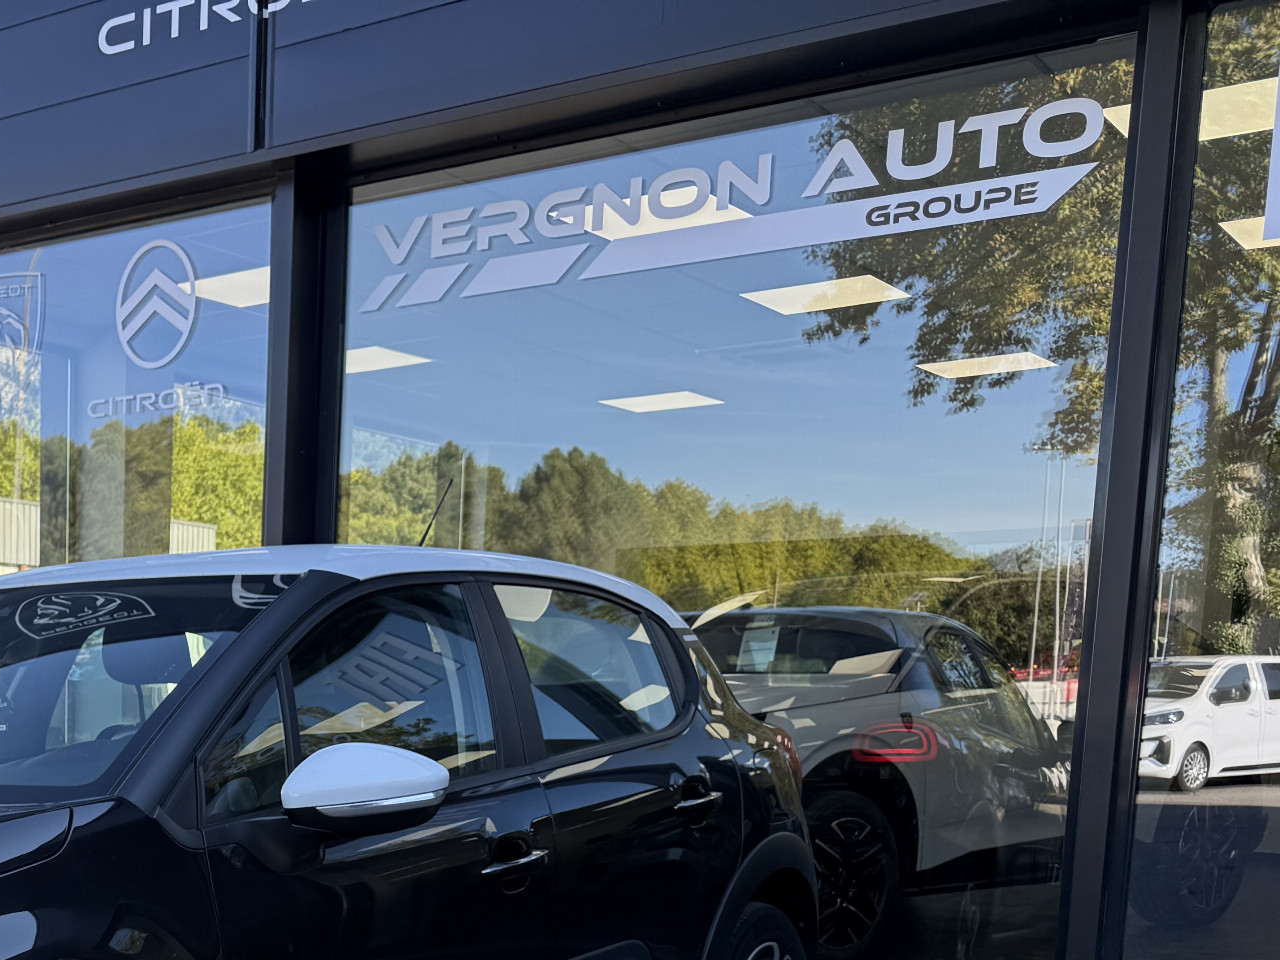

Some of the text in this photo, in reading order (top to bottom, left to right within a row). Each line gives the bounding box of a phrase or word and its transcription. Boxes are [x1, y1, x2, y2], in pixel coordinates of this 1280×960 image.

[98, 0, 312, 55] CITR
[373, 98, 1104, 265] VERGNON AUTO
[865, 181, 1040, 227] GROUPE
[87, 381, 224, 419] CITROËN
